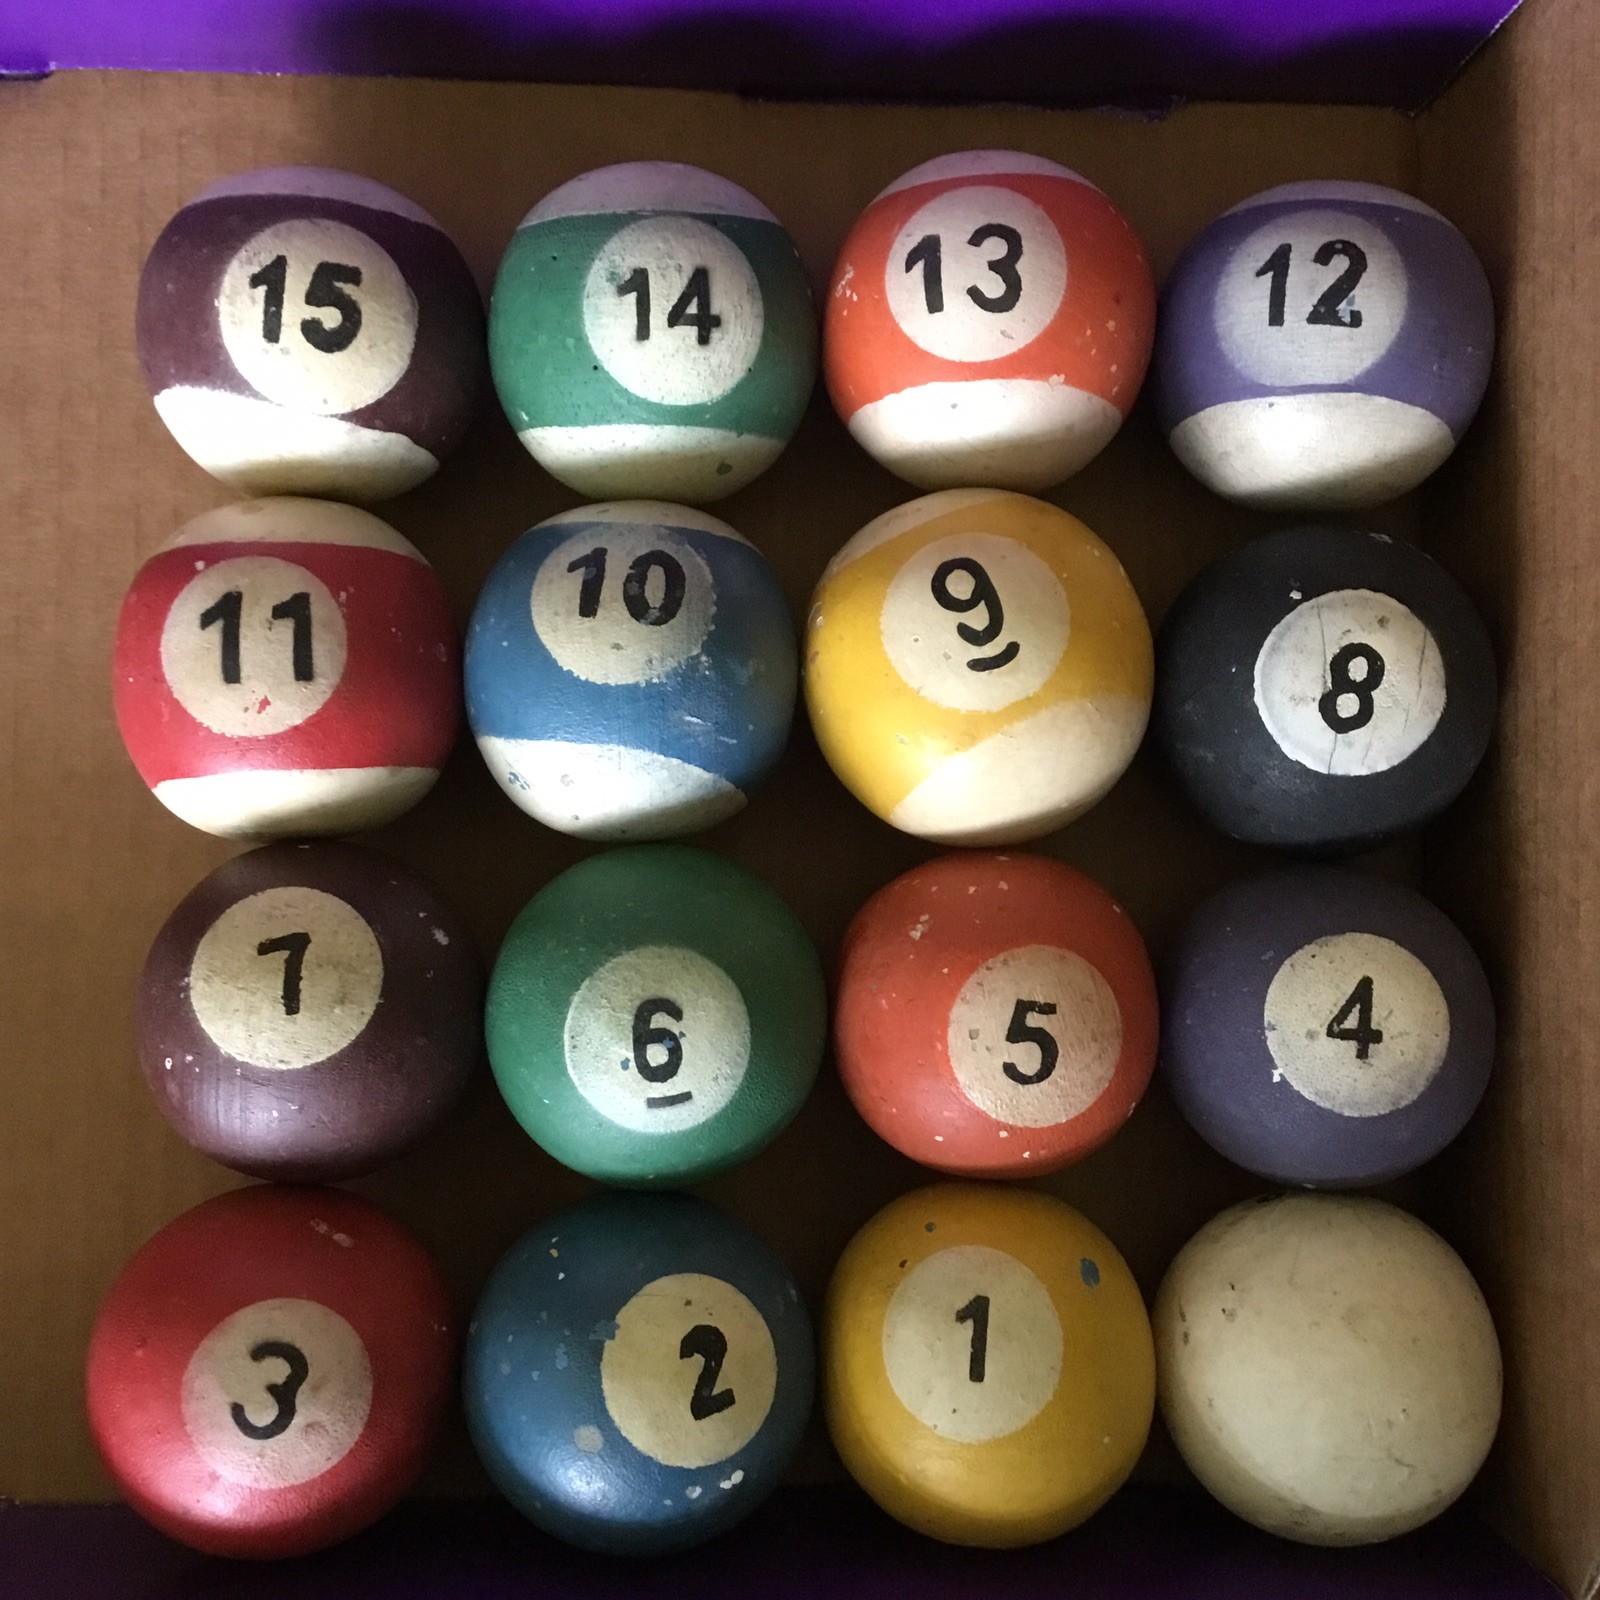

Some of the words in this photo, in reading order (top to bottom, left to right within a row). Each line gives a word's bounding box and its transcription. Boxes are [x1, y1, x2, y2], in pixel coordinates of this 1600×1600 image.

[249, 253, 363, 353] 15
[616, 266, 721, 346] 14
[903, 222, 1024, 314] 13
[1255, 238, 1368, 328] 12
[567, 546, 687, 626] 10
[931, 556, 1005, 648] 9
[200, 591, 315, 684] 11
[1319, 643, 1384, 734] 8
[257, 932, 312, 1015] 7
[1326, 976, 1383, 1060] 4
[632, 996, 686, 1083] 6
[1003, 998, 1059, 1085] 5
[680, 1325, 736, 1420] 2
[955, 1295, 990, 1383] 1
[231, 1338, 309, 1439] 3
